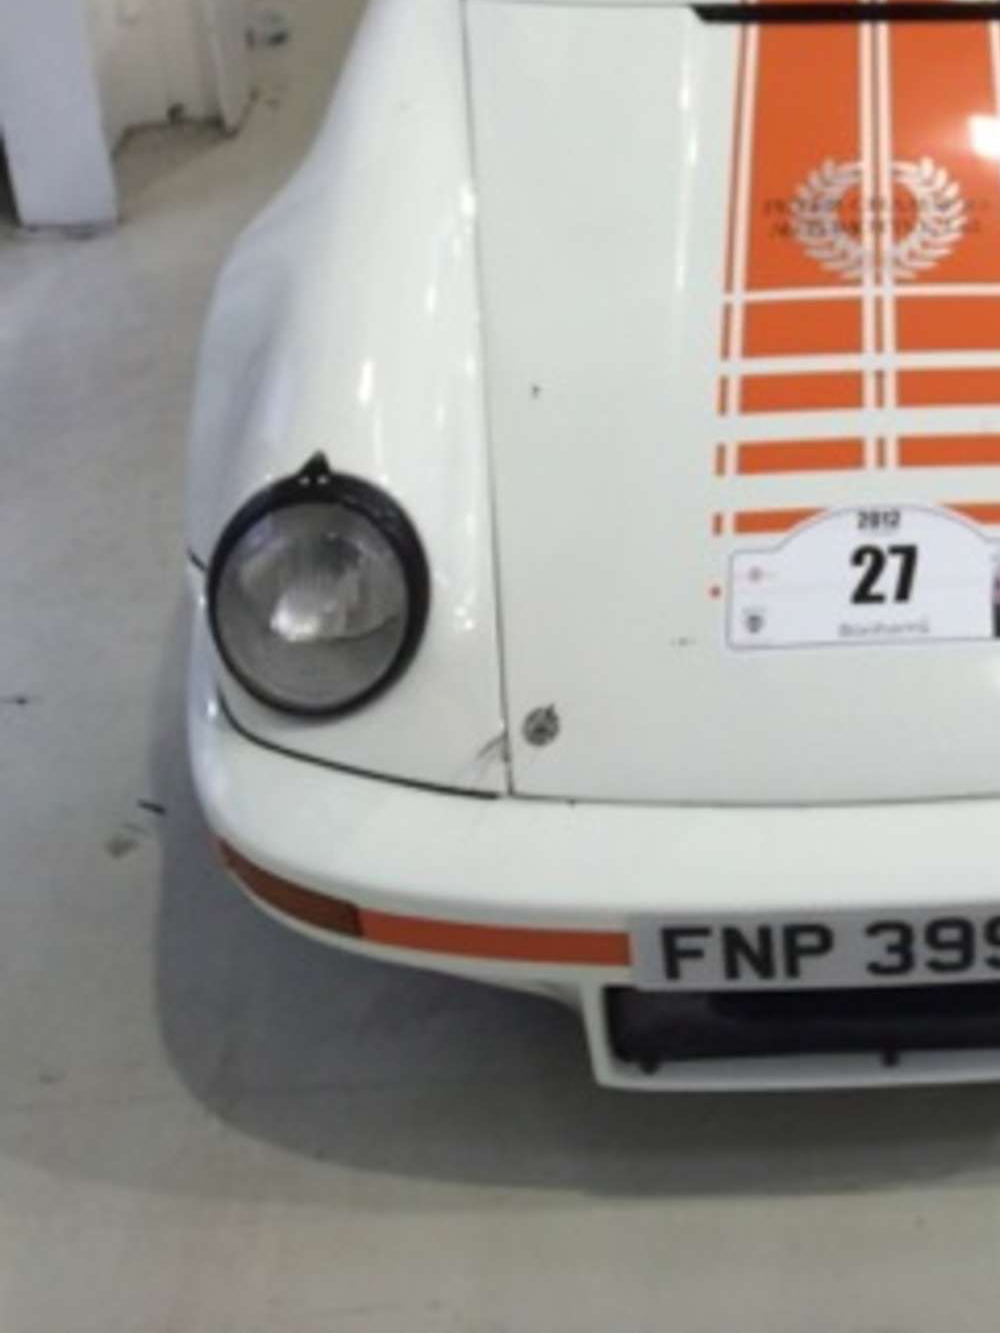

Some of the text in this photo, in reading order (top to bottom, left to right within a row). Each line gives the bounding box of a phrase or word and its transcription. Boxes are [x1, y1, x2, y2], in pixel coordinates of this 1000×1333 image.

[857, 509, 902, 530] 2012
[850, 543, 919, 605] 27
[660, 922, 834, 981] FNP
